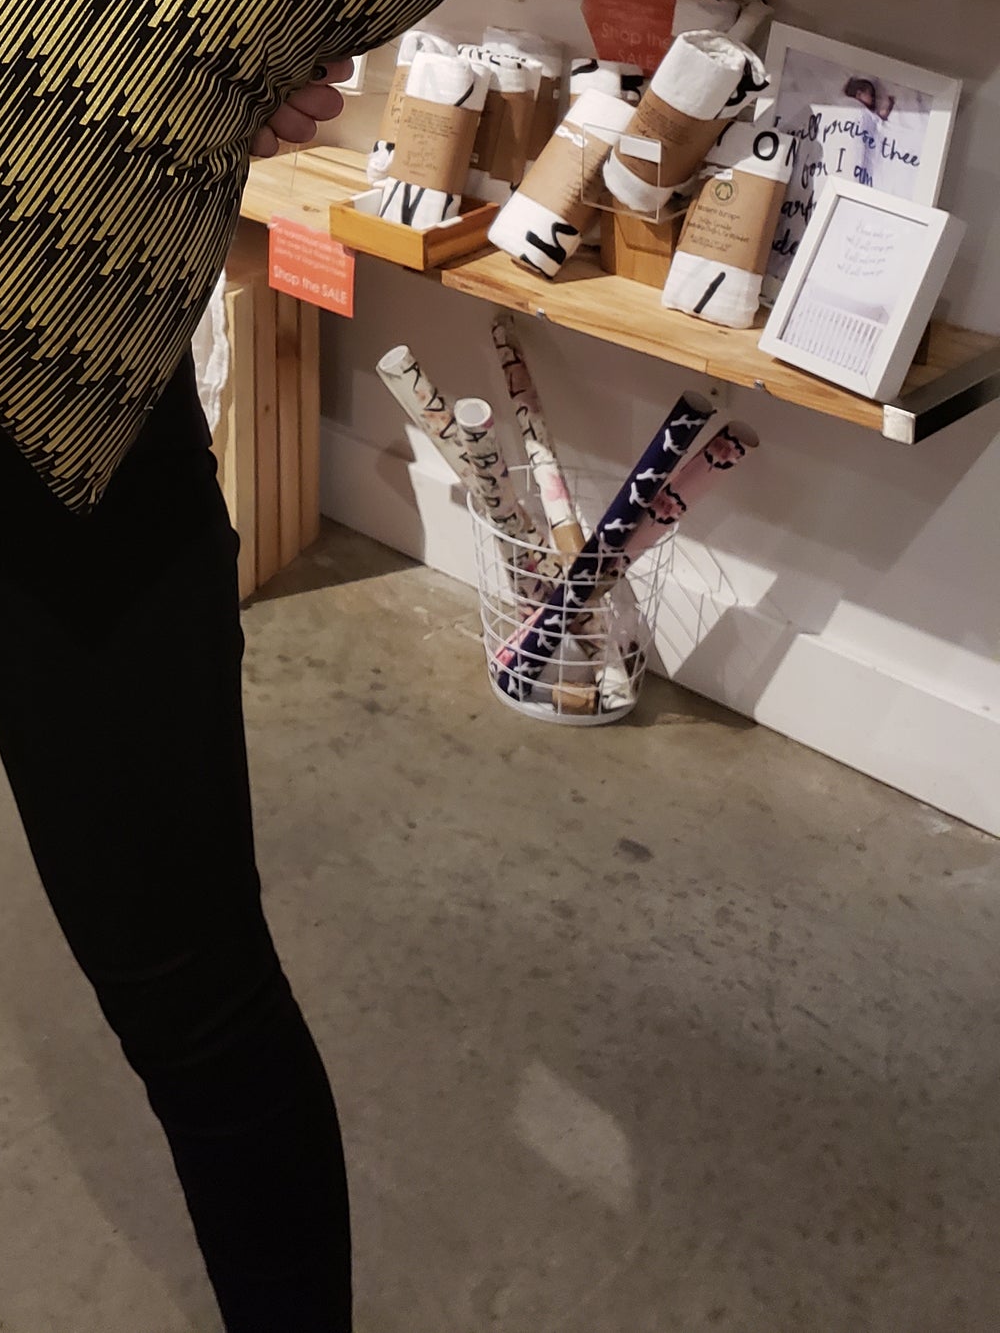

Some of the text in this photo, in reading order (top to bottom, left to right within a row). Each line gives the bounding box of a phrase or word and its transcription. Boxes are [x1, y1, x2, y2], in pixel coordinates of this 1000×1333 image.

[823, 119, 876, 149] praise
[881, 137, 921, 167] thee
[836, 148, 847, 173] I
[853, 165, 874, 188] am
[321, 283, 348, 306] SALE
